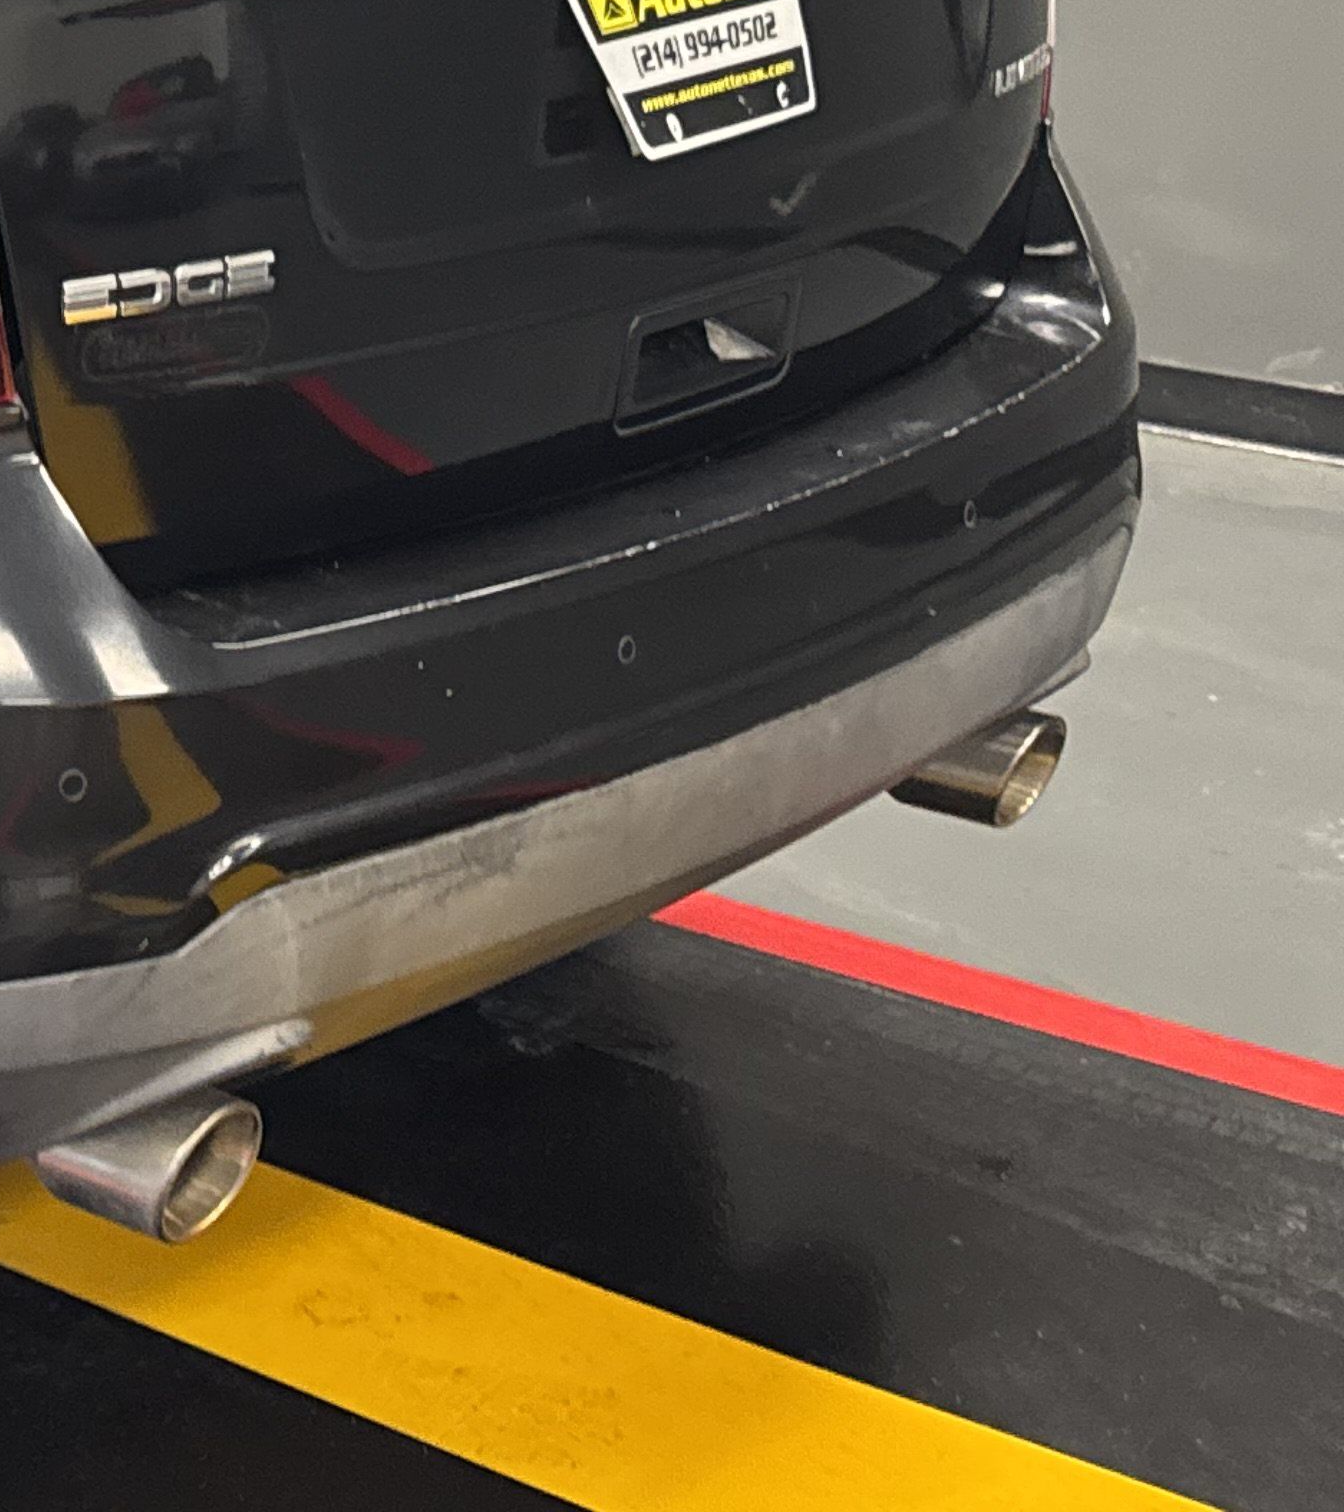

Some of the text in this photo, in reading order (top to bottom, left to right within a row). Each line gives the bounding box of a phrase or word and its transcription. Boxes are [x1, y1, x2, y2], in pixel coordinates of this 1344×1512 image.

[631, 11, 779, 79] (214) 994-0502
[63, 249, 275, 325] EDGE
